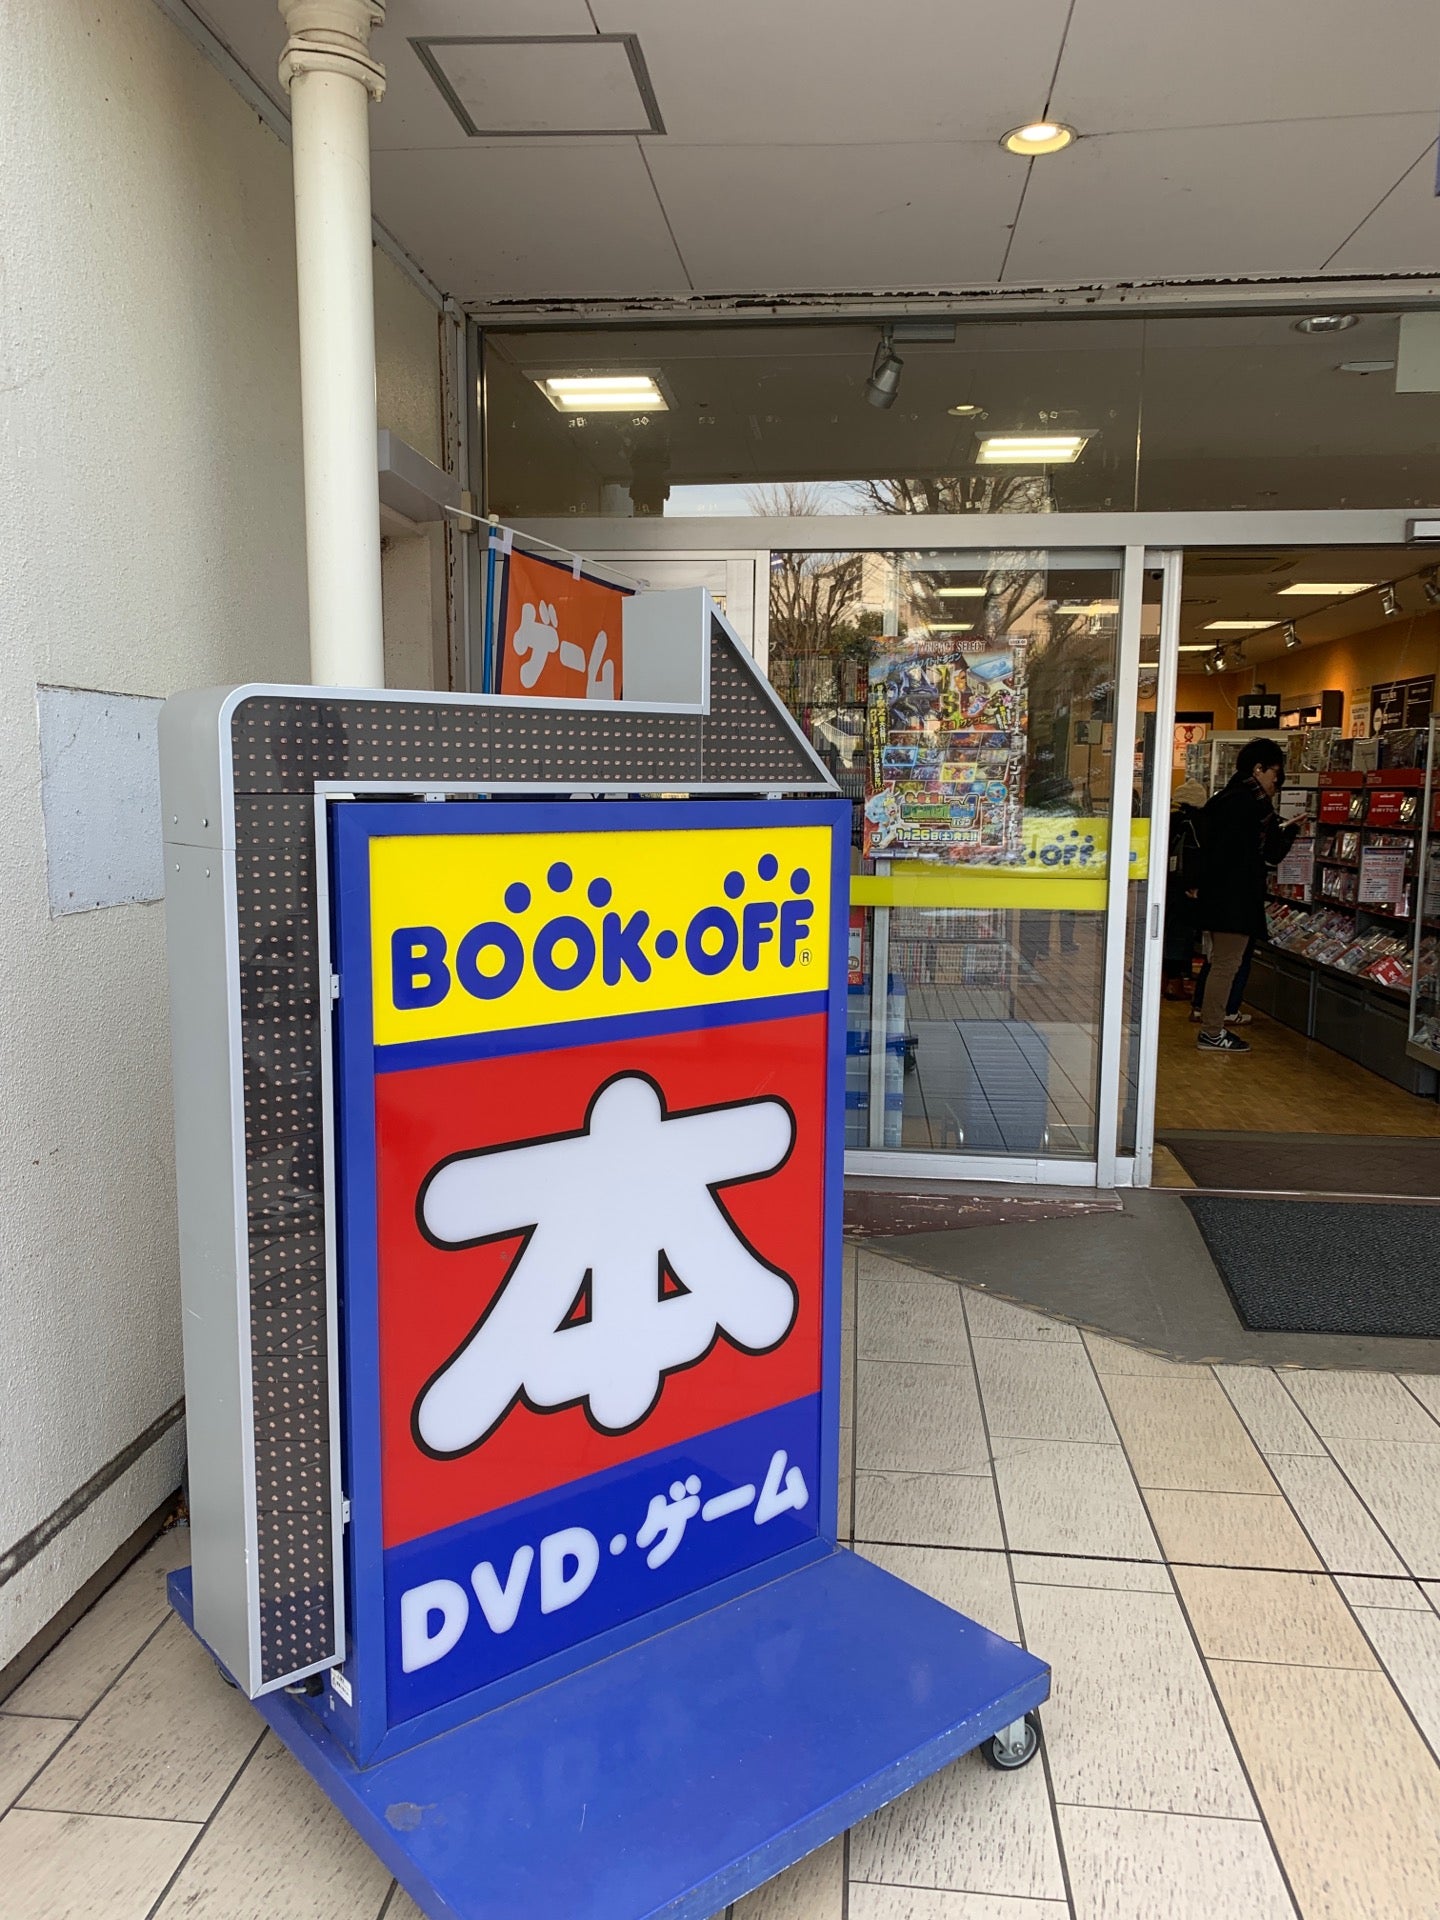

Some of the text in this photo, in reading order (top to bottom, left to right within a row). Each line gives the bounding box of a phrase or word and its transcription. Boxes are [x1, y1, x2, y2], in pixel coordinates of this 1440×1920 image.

[513, 599, 615, 700] ゲーム
[957, 640, 986, 652] SELECT
[1247, 704, 1278, 719] 買取
[413, 1072, 797, 1458] 本
